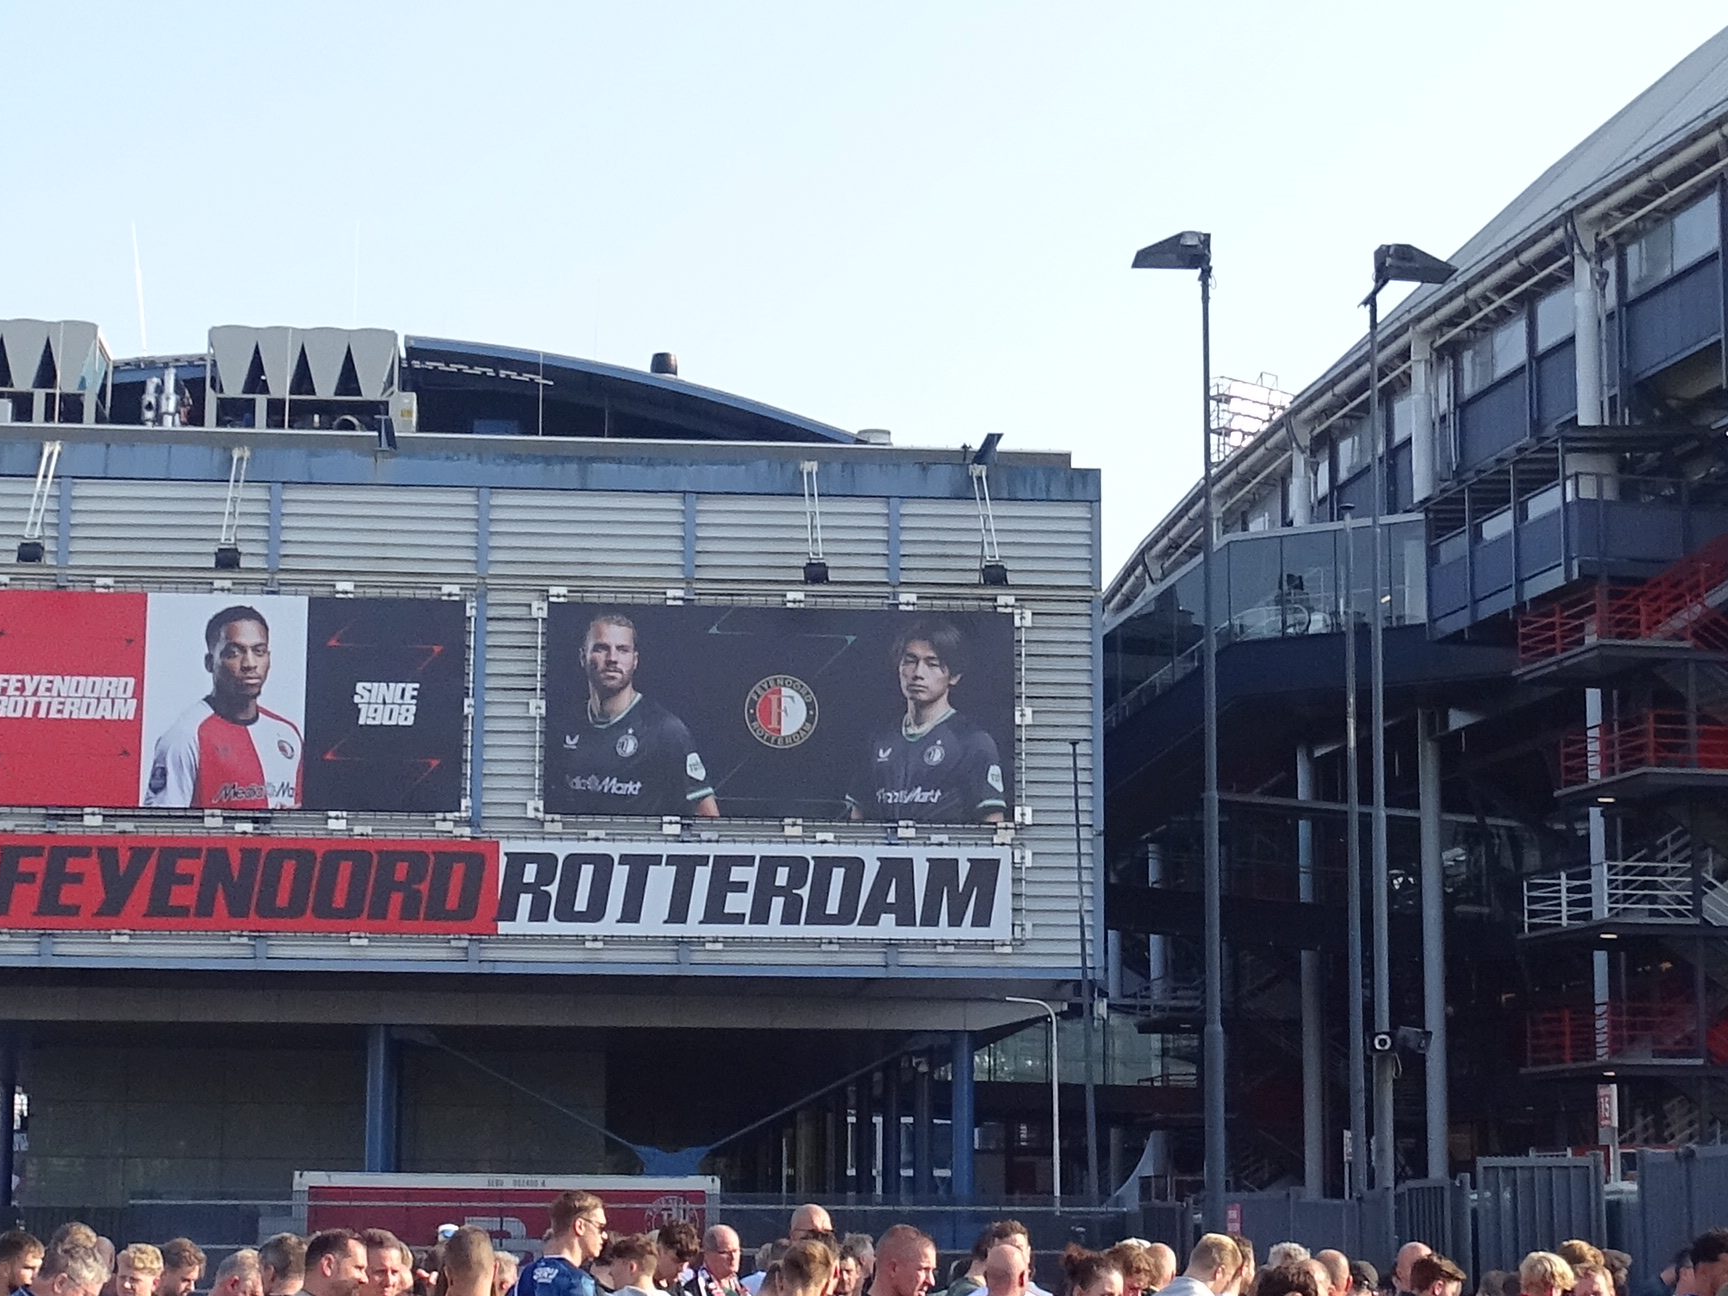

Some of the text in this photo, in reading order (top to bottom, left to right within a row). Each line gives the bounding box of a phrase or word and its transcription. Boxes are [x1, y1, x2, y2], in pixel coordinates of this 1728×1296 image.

[353, 681, 420, 705] SINCE
[357, 703, 418, 727] 1908
[494, 852, 1001, 928] ROTTERDAM
